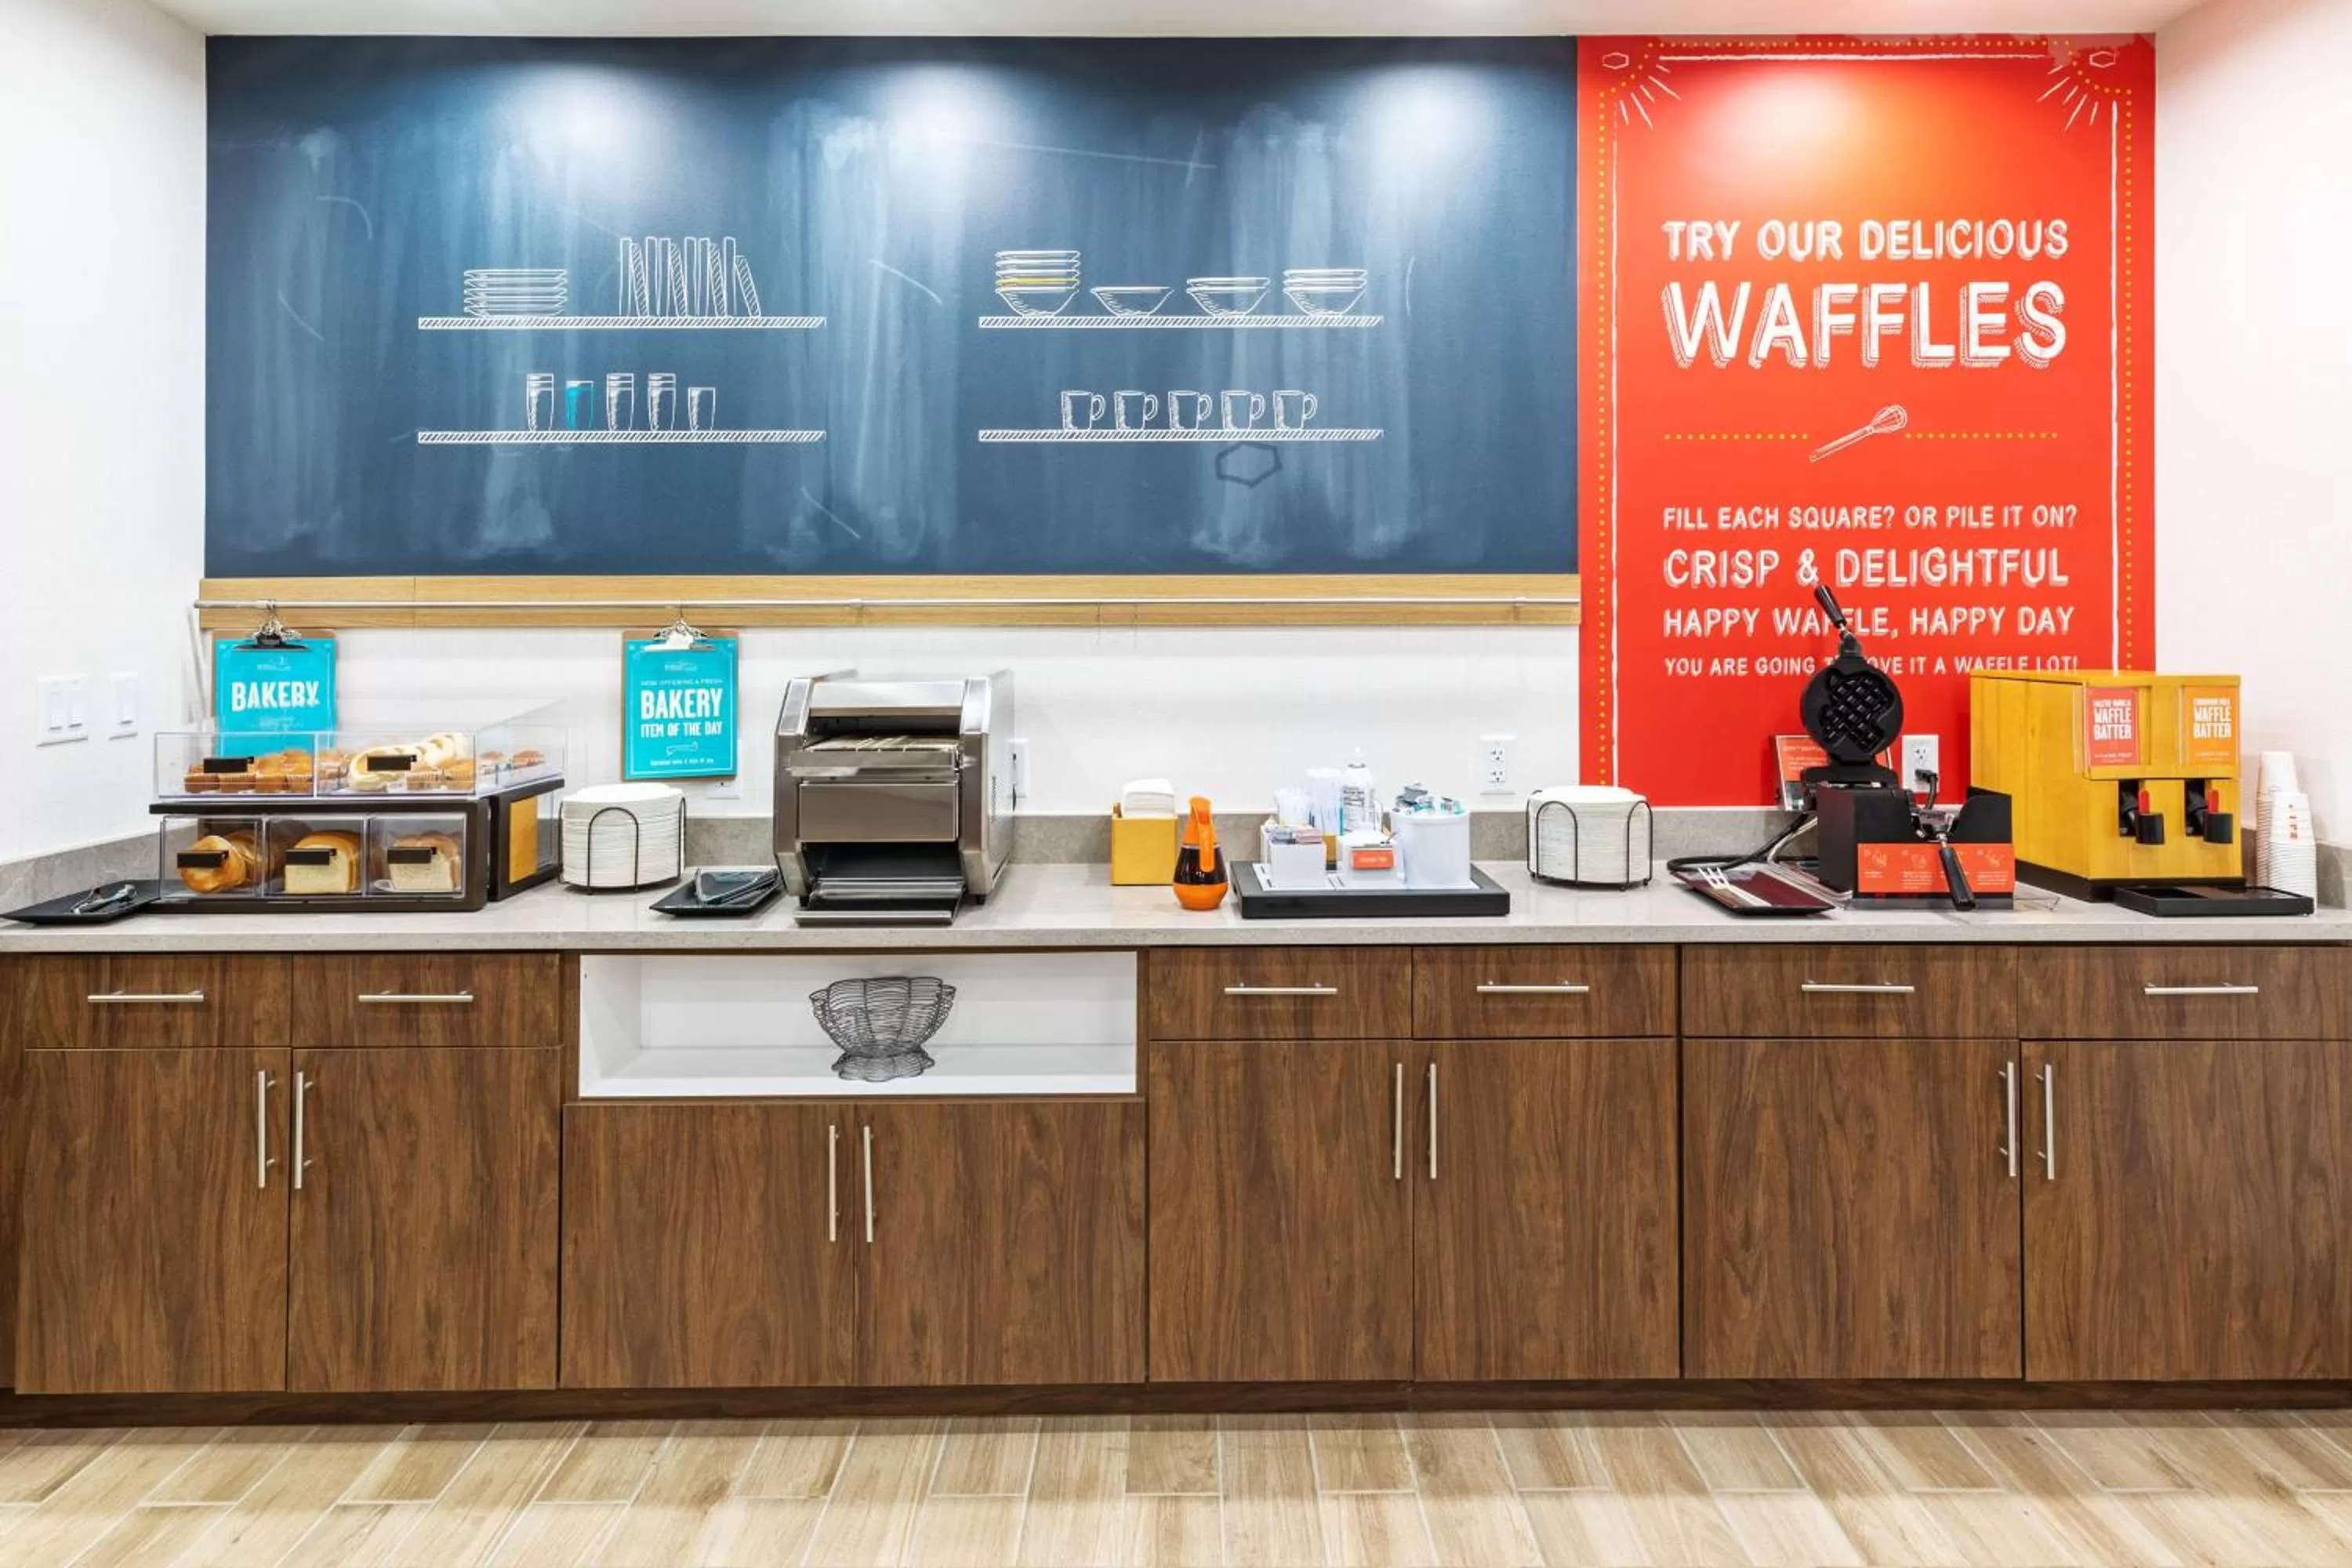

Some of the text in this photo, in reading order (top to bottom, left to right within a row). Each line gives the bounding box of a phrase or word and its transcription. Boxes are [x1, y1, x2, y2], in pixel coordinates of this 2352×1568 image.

[1662, 219, 2068, 261] TRY OUR DELICIOUS
[1661, 281, 2066, 368] WAFFLES
[1664, 505, 2077, 530] FILL EACH SQUARE? OR PILE IT ON?
[1664, 547, 2069, 587] CRISP & DELIGHTFUL
[1664, 608, 1759, 637] HAPPY
[1910, 606, 2005, 635] HAPPY
[2018, 606, 2074, 634] DAY
[1665, 658, 1702, 676] YOU
[1710, 657, 1748, 676] ARE
[1755, 656, 1815, 675] GOING
[1867, 656, 1903, 674] OVE
[1910, 657, 1926, 674] IT
[1934, 656, 1946, 674] A
[1954, 655, 2028, 673] WAFFLE
[2036, 655, 2078, 674] LOT!
[231, 681, 320, 713] BAKERY
[641, 688, 723, 720] BAKERY
[2094, 707, 2132, 724] WAFFLE
[2194, 706, 2233, 722] WAFFLE
[641, 720, 722, 739] ITEM OF THE DAY
[2094, 724, 2132, 740] BATTER
[2193, 721, 2233, 739] BATTER
